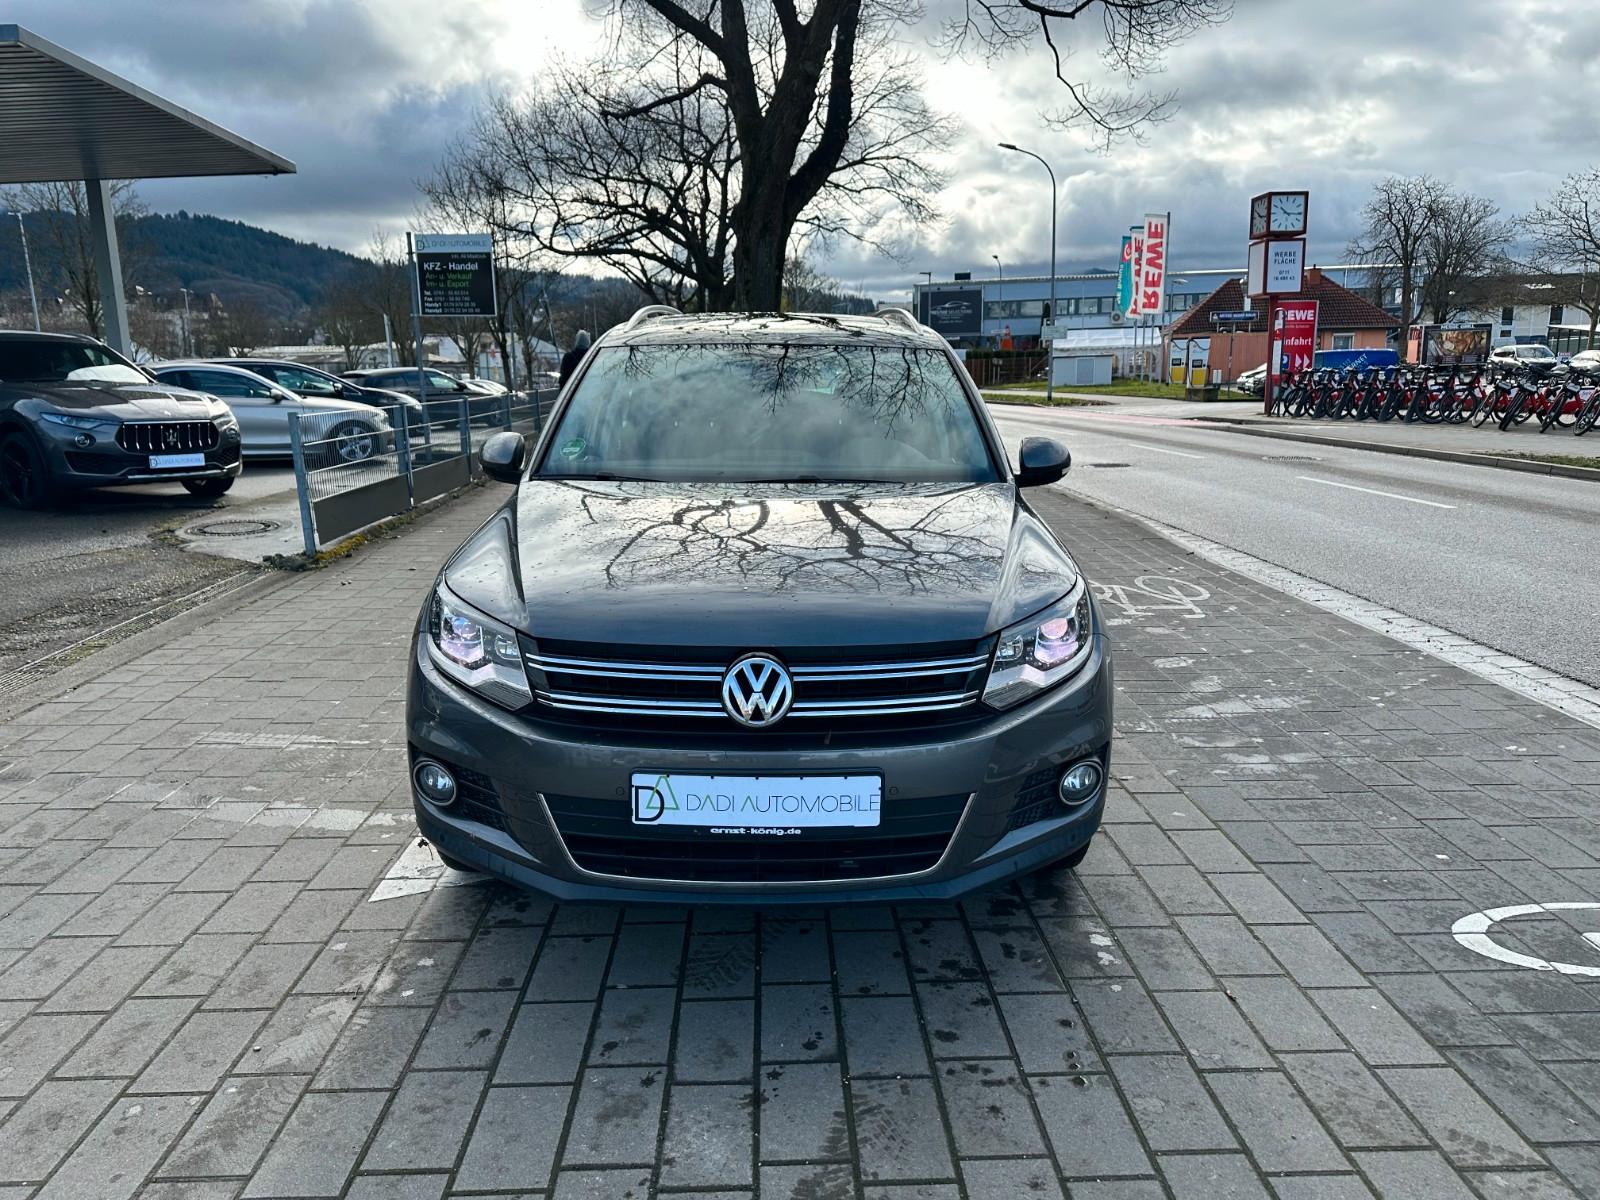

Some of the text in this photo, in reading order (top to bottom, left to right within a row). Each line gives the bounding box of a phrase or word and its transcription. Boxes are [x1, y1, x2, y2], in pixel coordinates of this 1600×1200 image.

[423, 262, 441, 271] KFZ
[448, 262, 479, 271] Handel
[425, 272, 438, 280] An-
[447, 272, 472, 280] Verkauf
[447, 280, 470, 289] Export
[1284, 336, 1312, 346] infahrt
[686, 793, 881, 813] DADI AUTOMOBILE
[710, 827, 802, 836] ernst-könig.de
